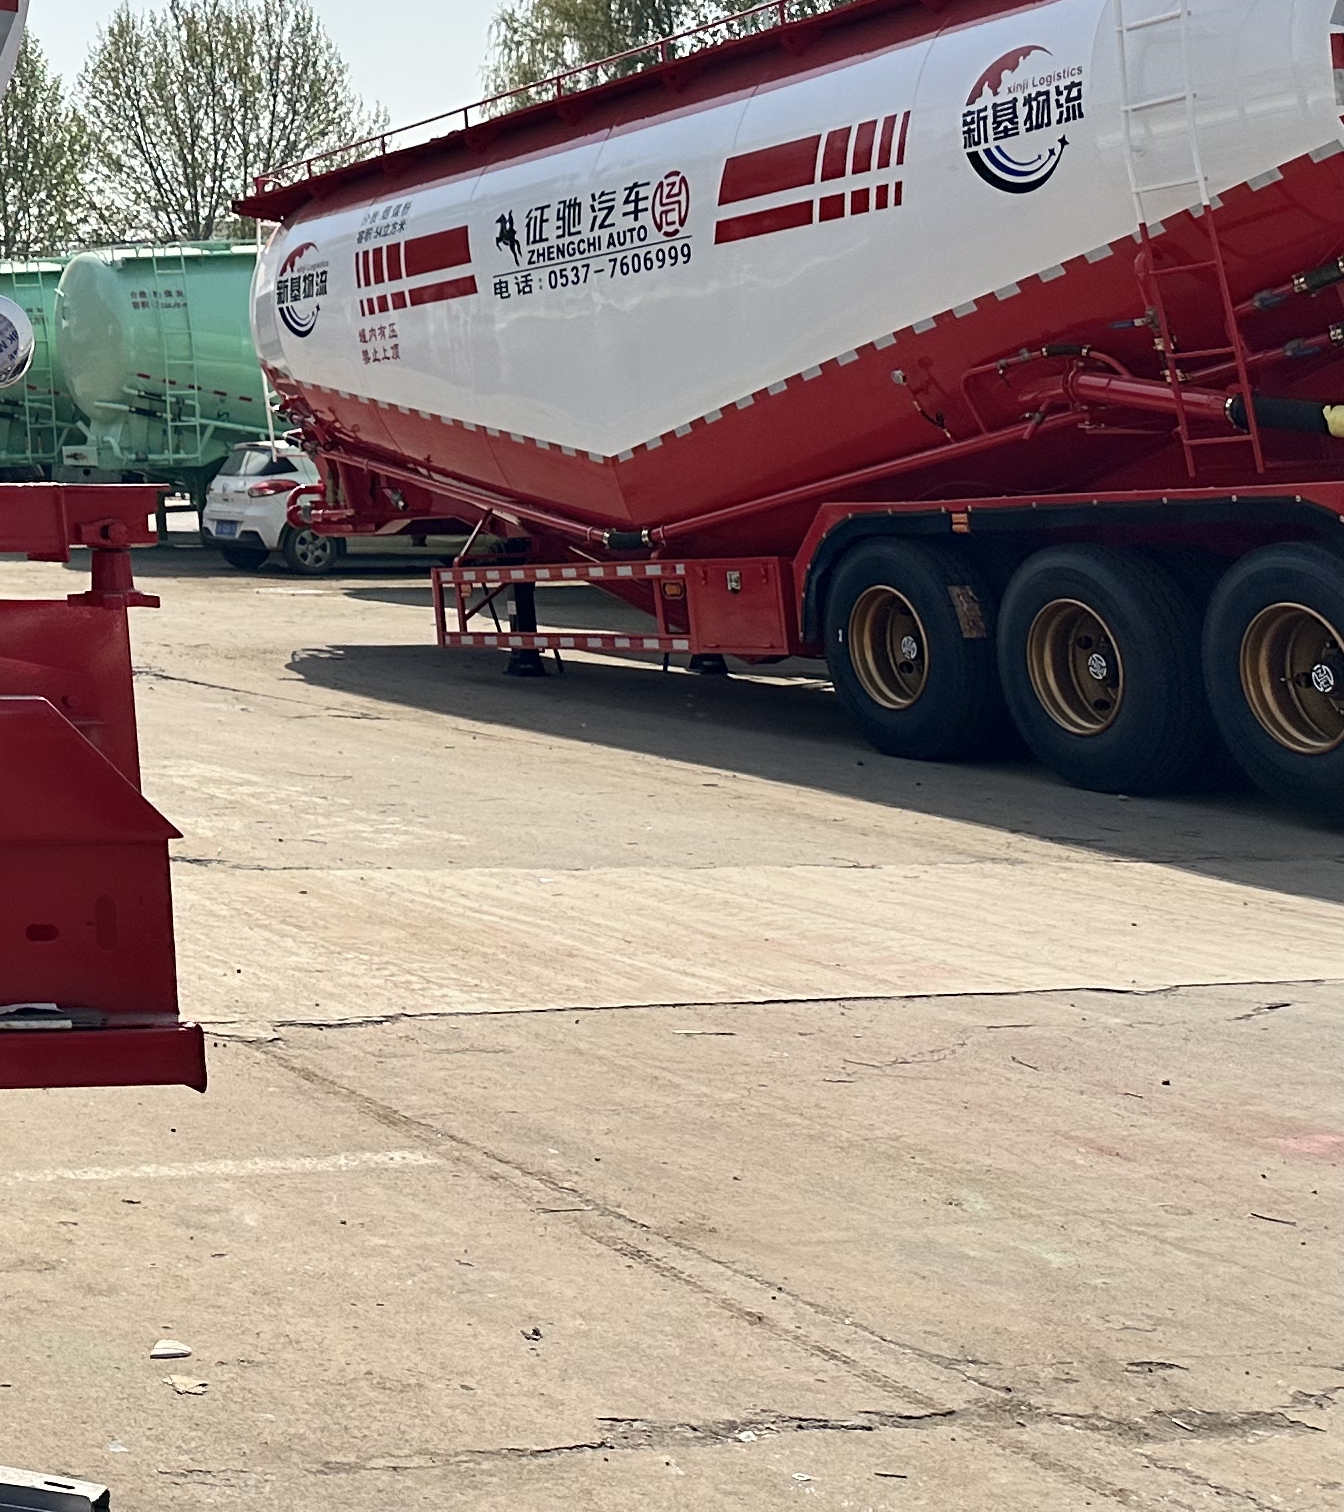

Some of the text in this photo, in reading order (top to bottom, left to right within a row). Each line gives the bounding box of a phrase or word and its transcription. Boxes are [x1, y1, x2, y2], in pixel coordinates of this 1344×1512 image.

[1032, 65, 1083, 87] Logistics
[962, 80, 1084, 149] 新基物流
[525, 181, 650, 246] 征驰汽车
[527, 225, 648, 266] ZHENGCHI AUTO
